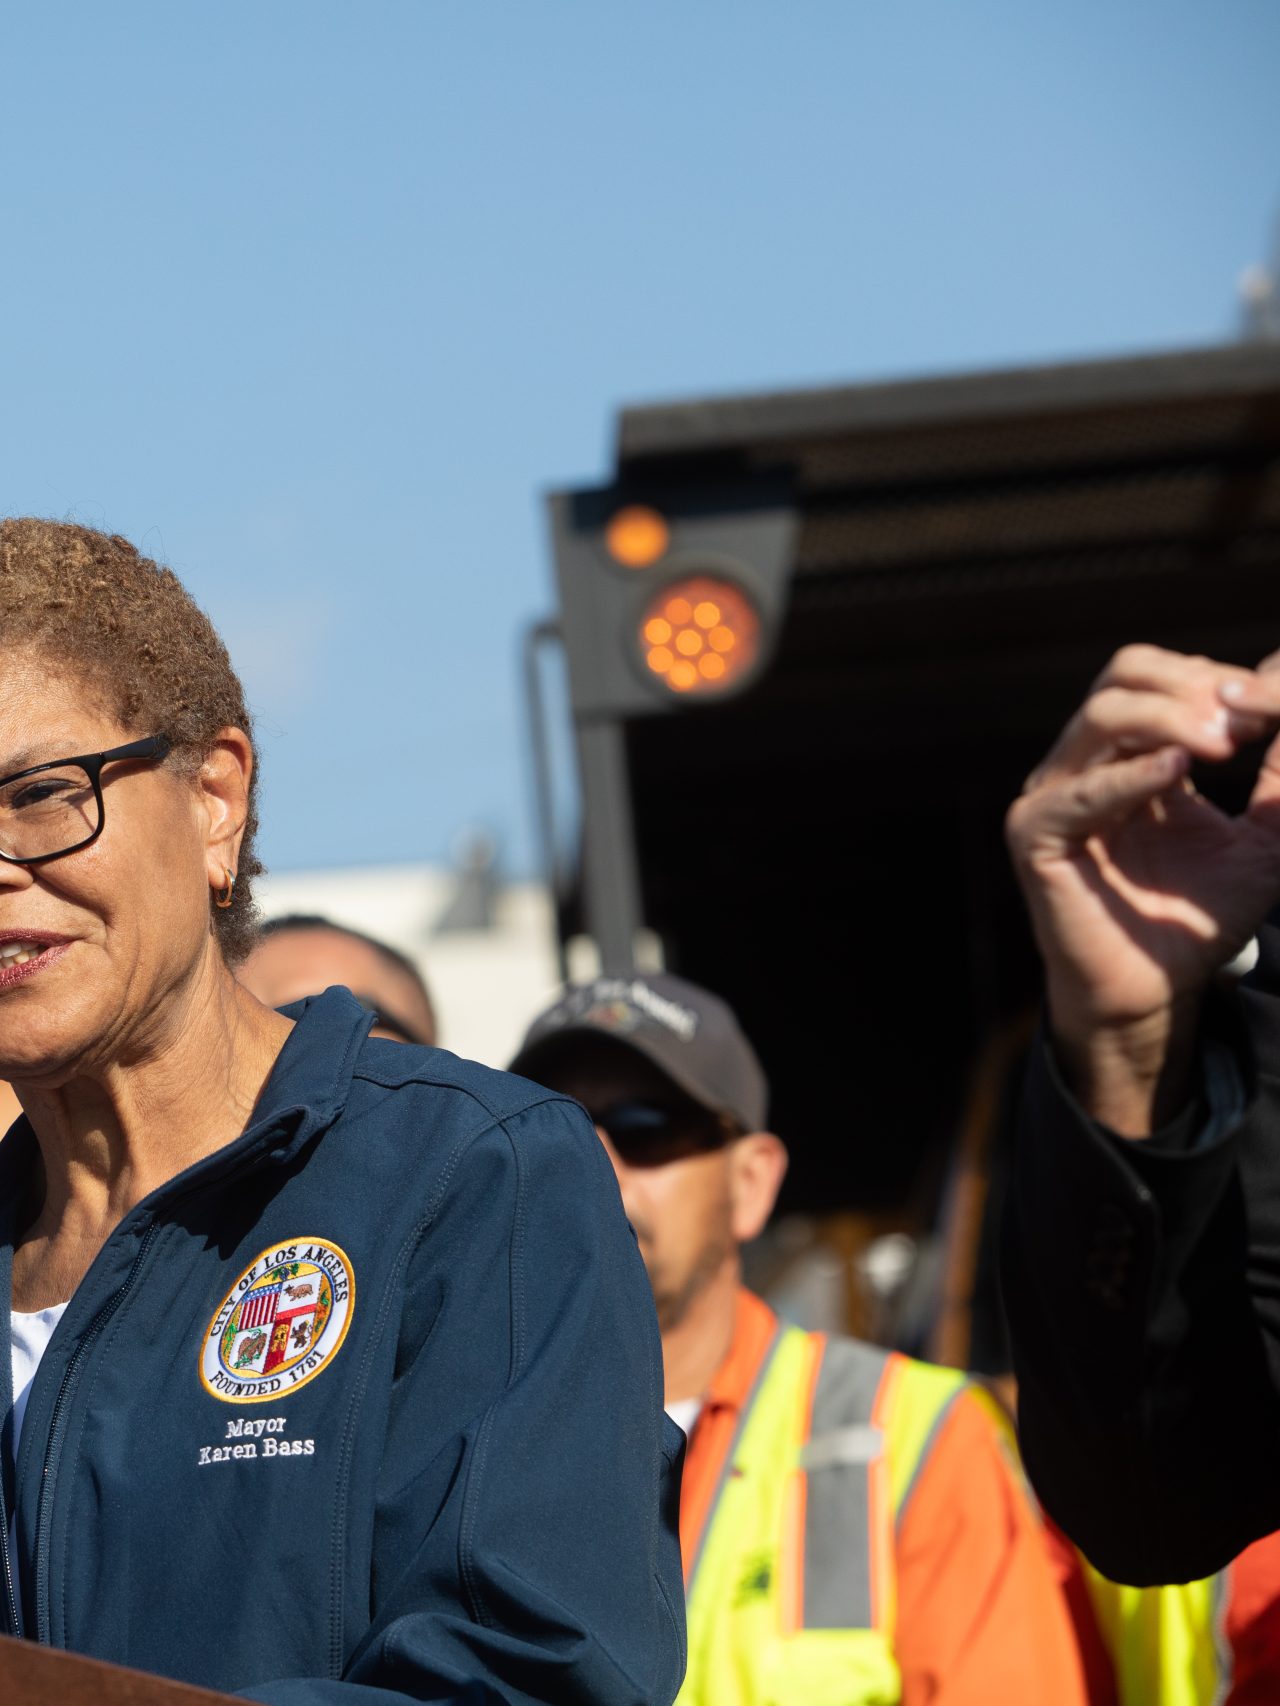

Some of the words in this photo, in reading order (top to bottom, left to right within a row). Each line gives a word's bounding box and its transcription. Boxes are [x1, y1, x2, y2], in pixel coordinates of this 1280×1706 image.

[210, 1298, 237, 1337] CITY
[238, 1266, 257, 1292] OF
[264, 1245, 298, 1270] LOS
[301, 1245, 349, 1303] ANGELES
[209, 1370, 281, 1397] FOUNDED
[288, 1351, 325, 1385] 1781
[225, 1416, 287, 1440] Mayor
[198, 1441, 258, 1466] Karen
[262, 1437, 316, 1457] Bass
